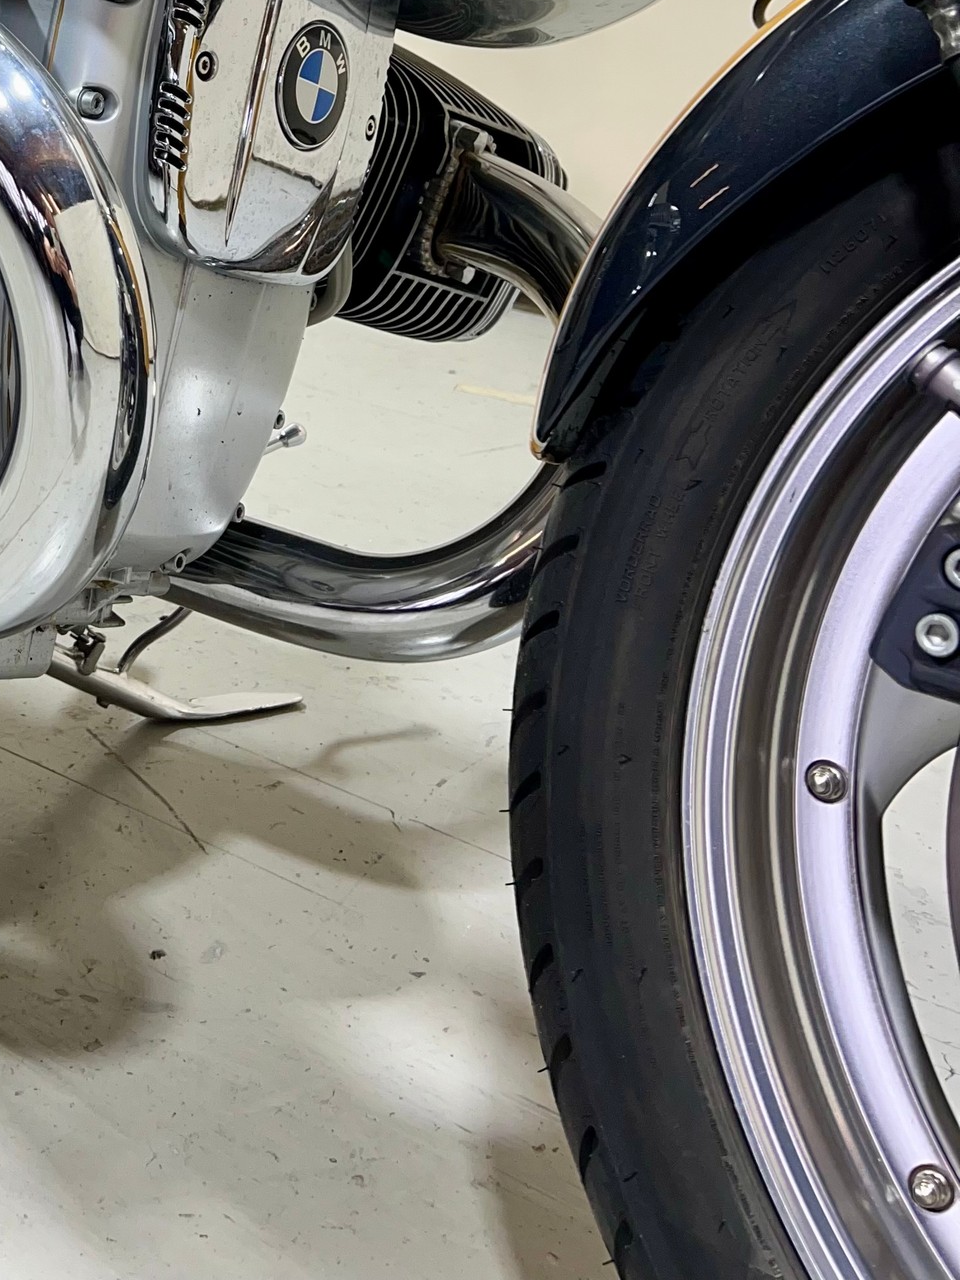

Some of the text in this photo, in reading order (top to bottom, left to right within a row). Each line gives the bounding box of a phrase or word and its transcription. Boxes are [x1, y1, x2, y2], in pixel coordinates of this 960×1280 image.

[296, 29, 346, 75] BMW
[702, 337, 768, 423] ROTATION
[615, 495, 660, 603] VORDERRAD
